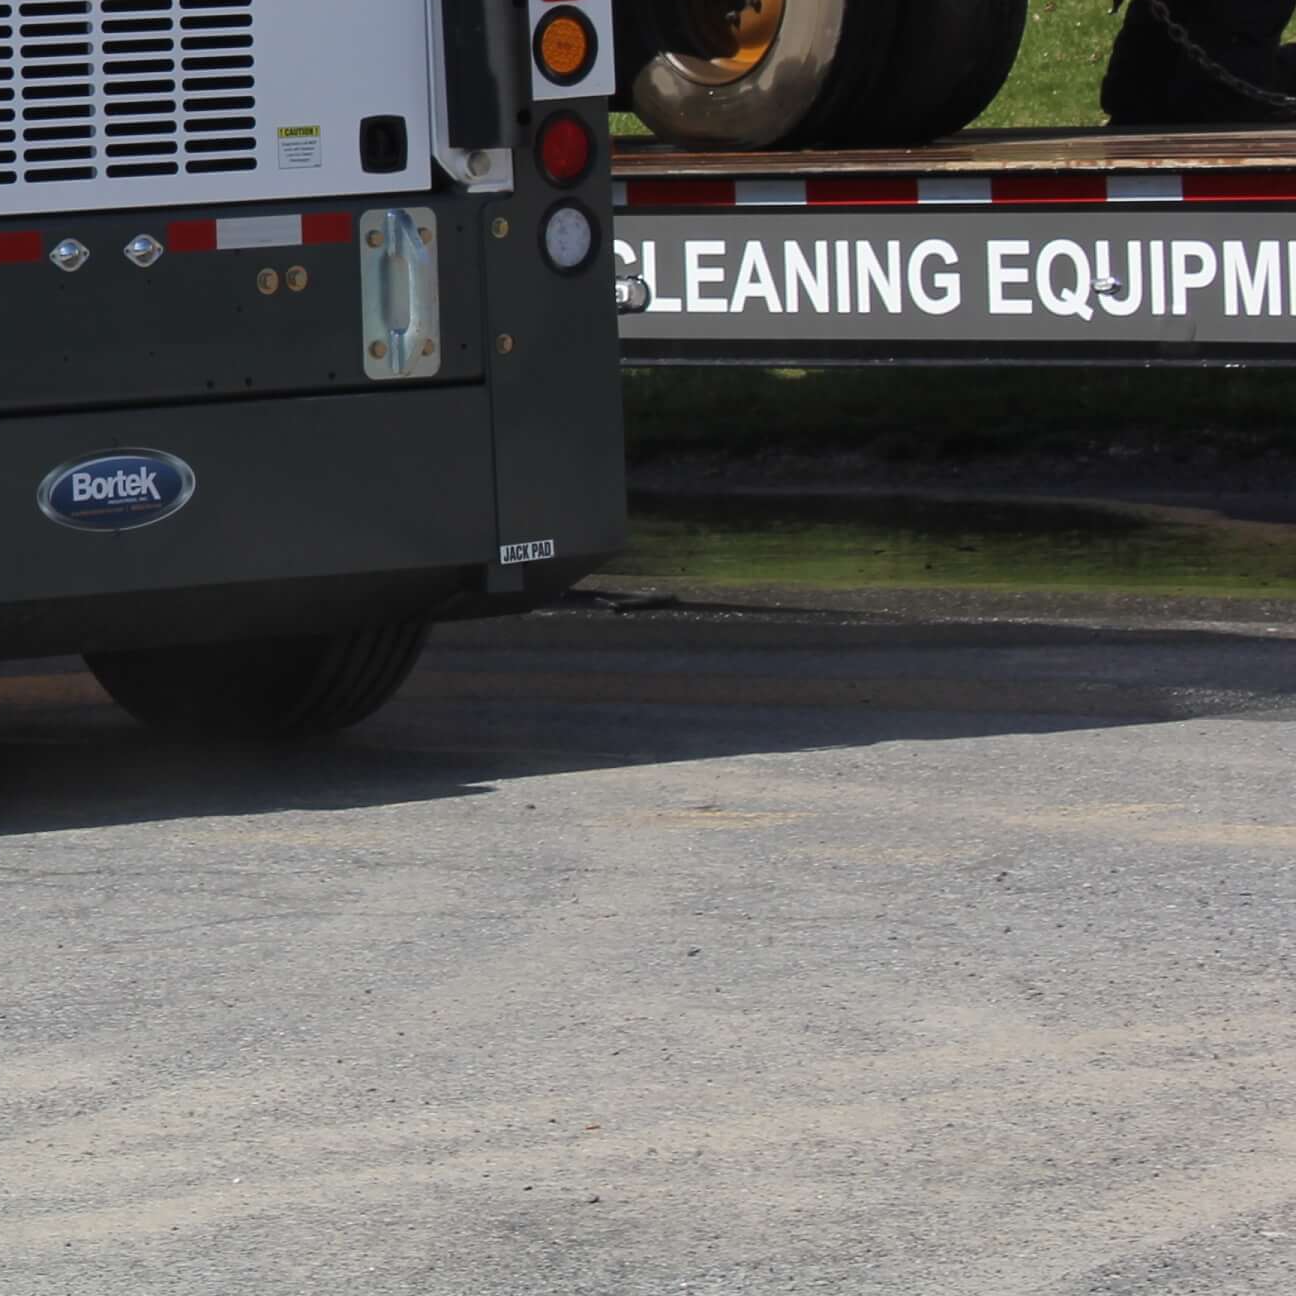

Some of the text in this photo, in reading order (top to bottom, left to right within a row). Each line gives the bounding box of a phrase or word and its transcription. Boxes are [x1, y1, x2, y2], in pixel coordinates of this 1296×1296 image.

[614, 239, 962, 316] LEANING
[71, 466, 161, 503] Bortek
[503, 542, 551, 562] JACK PAD
